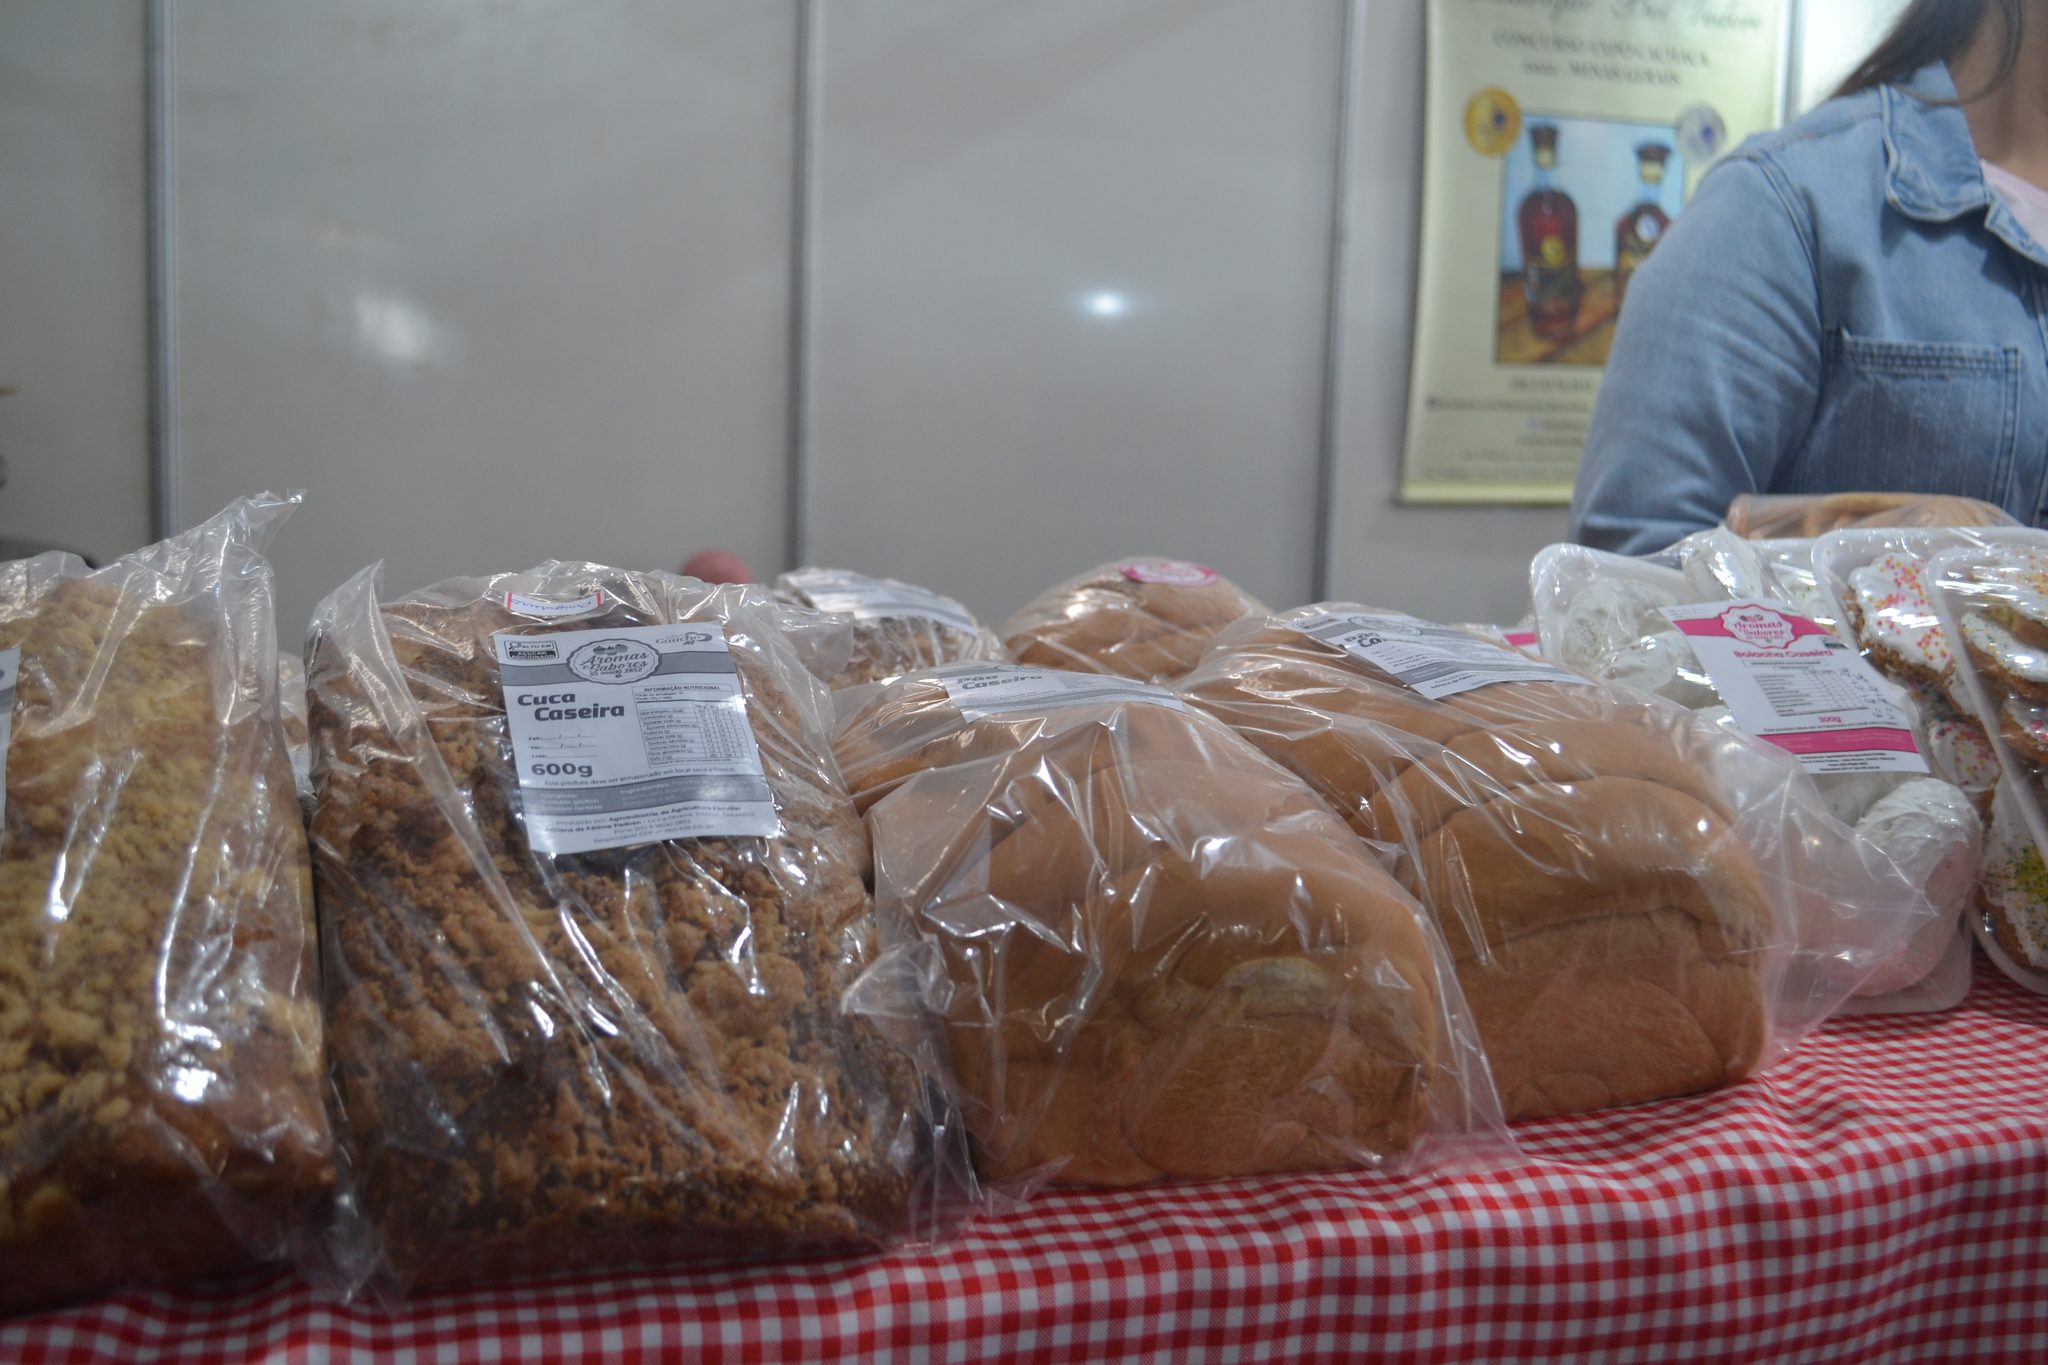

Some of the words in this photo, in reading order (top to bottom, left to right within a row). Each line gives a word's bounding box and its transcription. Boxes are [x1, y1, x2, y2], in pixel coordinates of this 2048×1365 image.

[580, 652, 649, 667] Aromas
[962, 675, 1043, 690] Caseiro
[517, 693, 576, 706] Cuca
[534, 702, 625, 721] Caseira
[531, 762, 593, 778] 600g
[620, 770, 662, 781] armazenado
